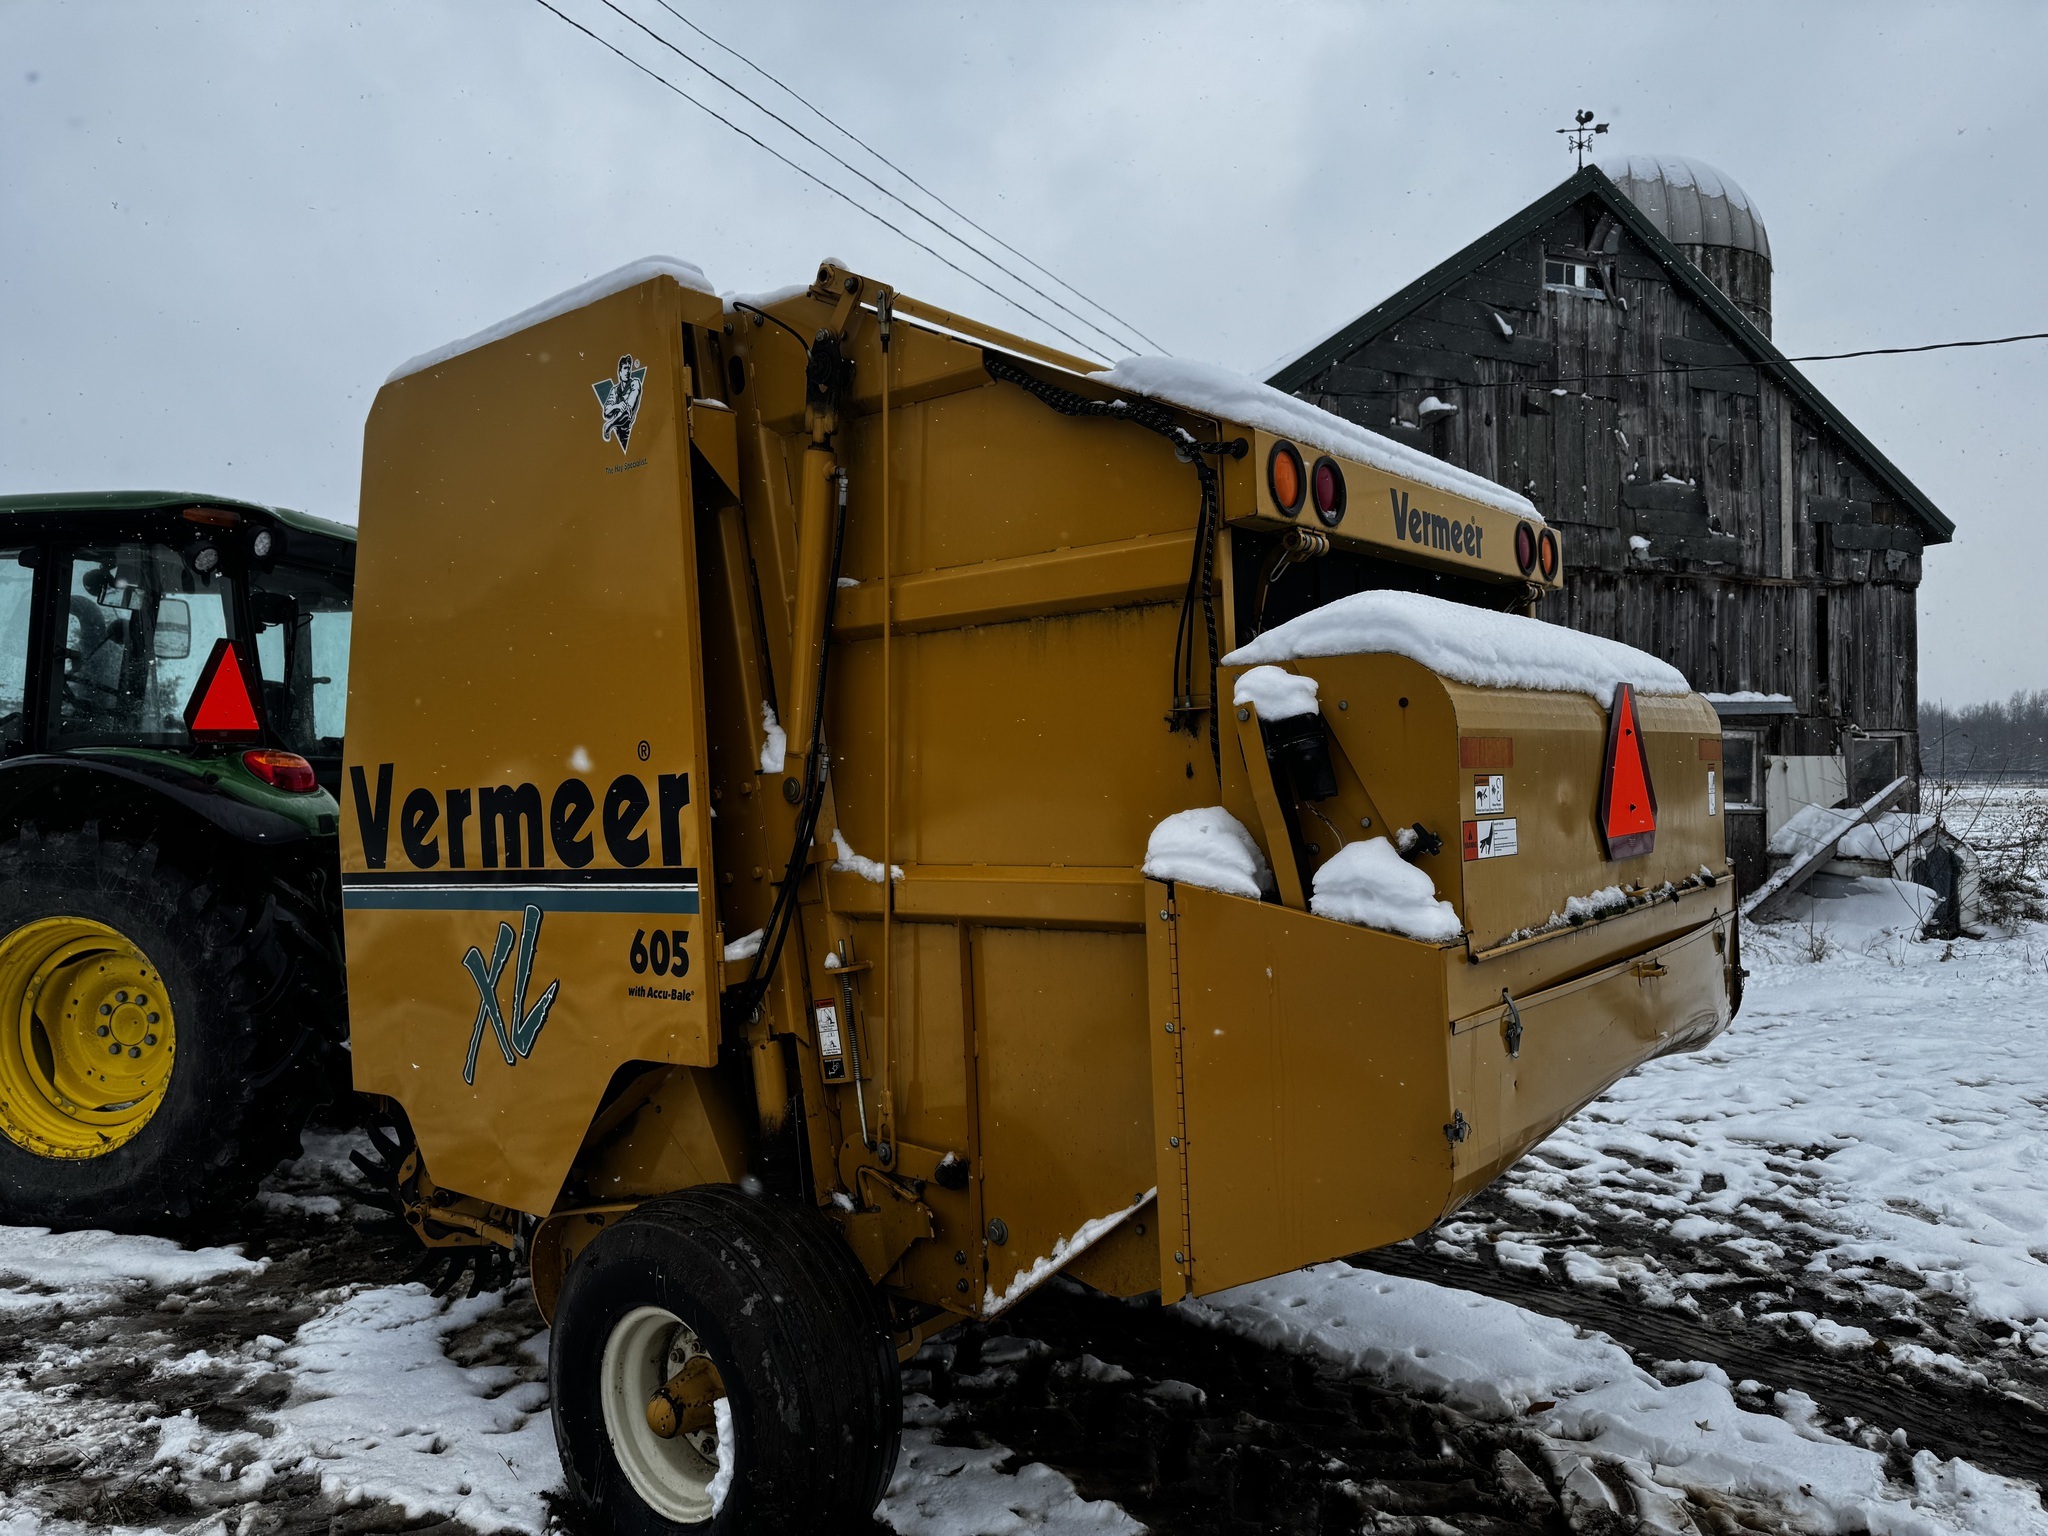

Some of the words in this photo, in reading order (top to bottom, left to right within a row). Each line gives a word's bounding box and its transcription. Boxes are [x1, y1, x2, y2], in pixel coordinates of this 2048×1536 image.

[629, 928, 690, 978] 605
[462, 903, 560, 1086] XL
[628, 985, 646, 998] with
